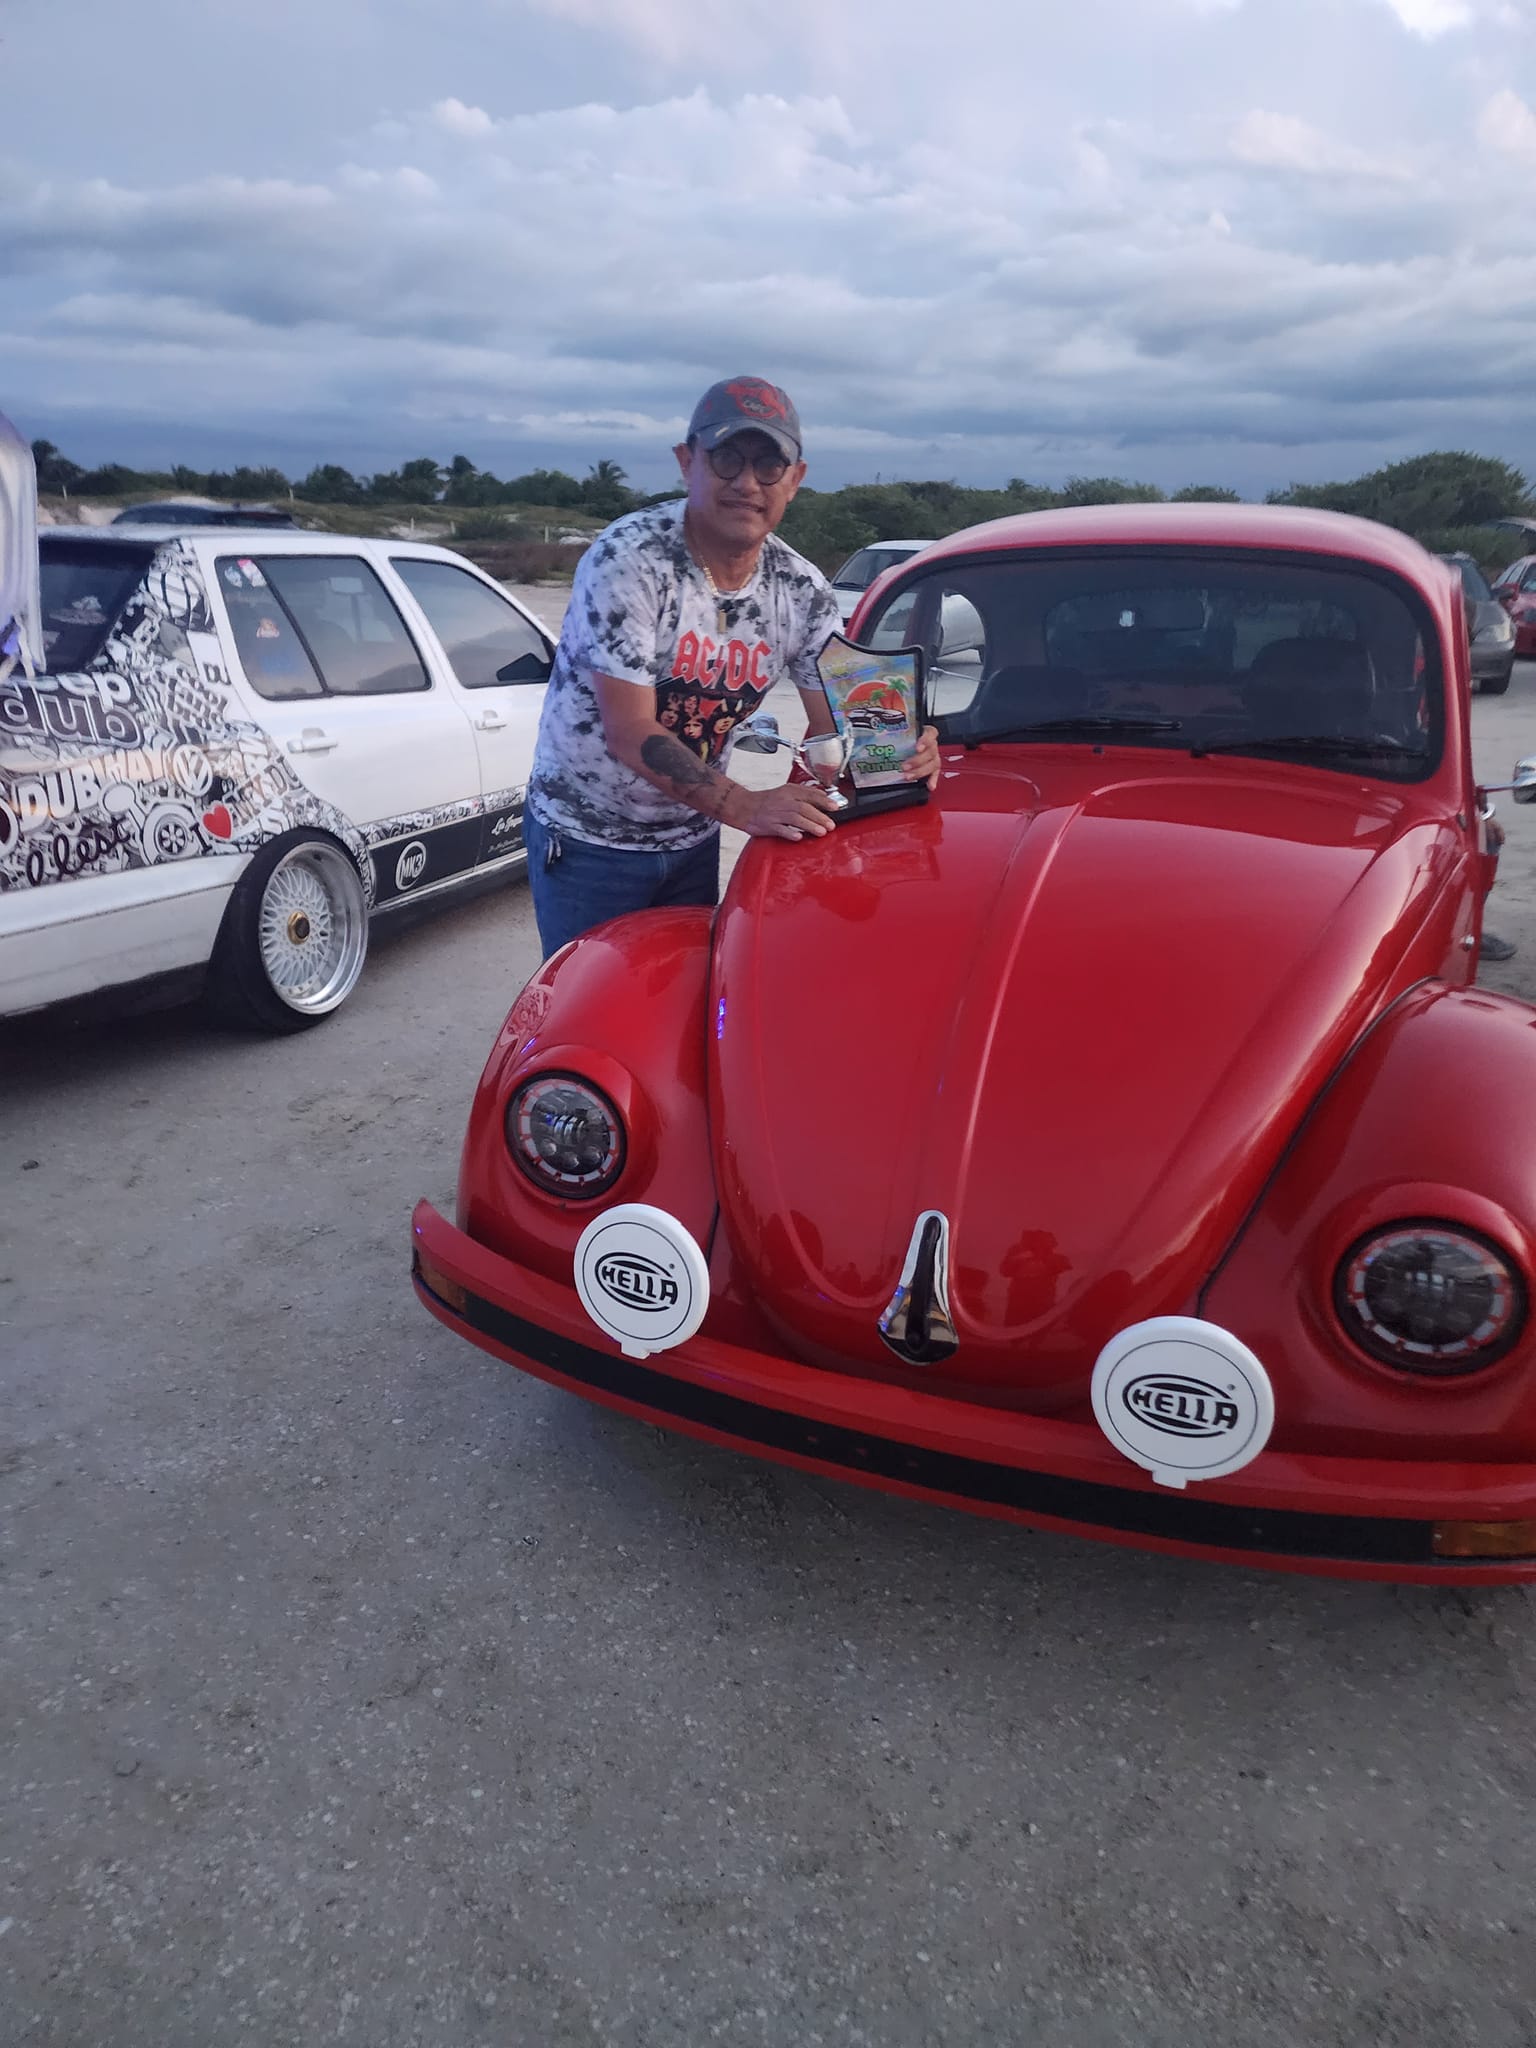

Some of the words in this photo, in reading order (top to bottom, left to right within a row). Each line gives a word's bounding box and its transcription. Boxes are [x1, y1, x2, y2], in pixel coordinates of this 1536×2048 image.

[865, 744, 895, 760] Top
[401, 853, 424, 879] MK3
[601, 1265, 678, 1305] HELLA
[1132, 1389, 1238, 1430] HELLA
